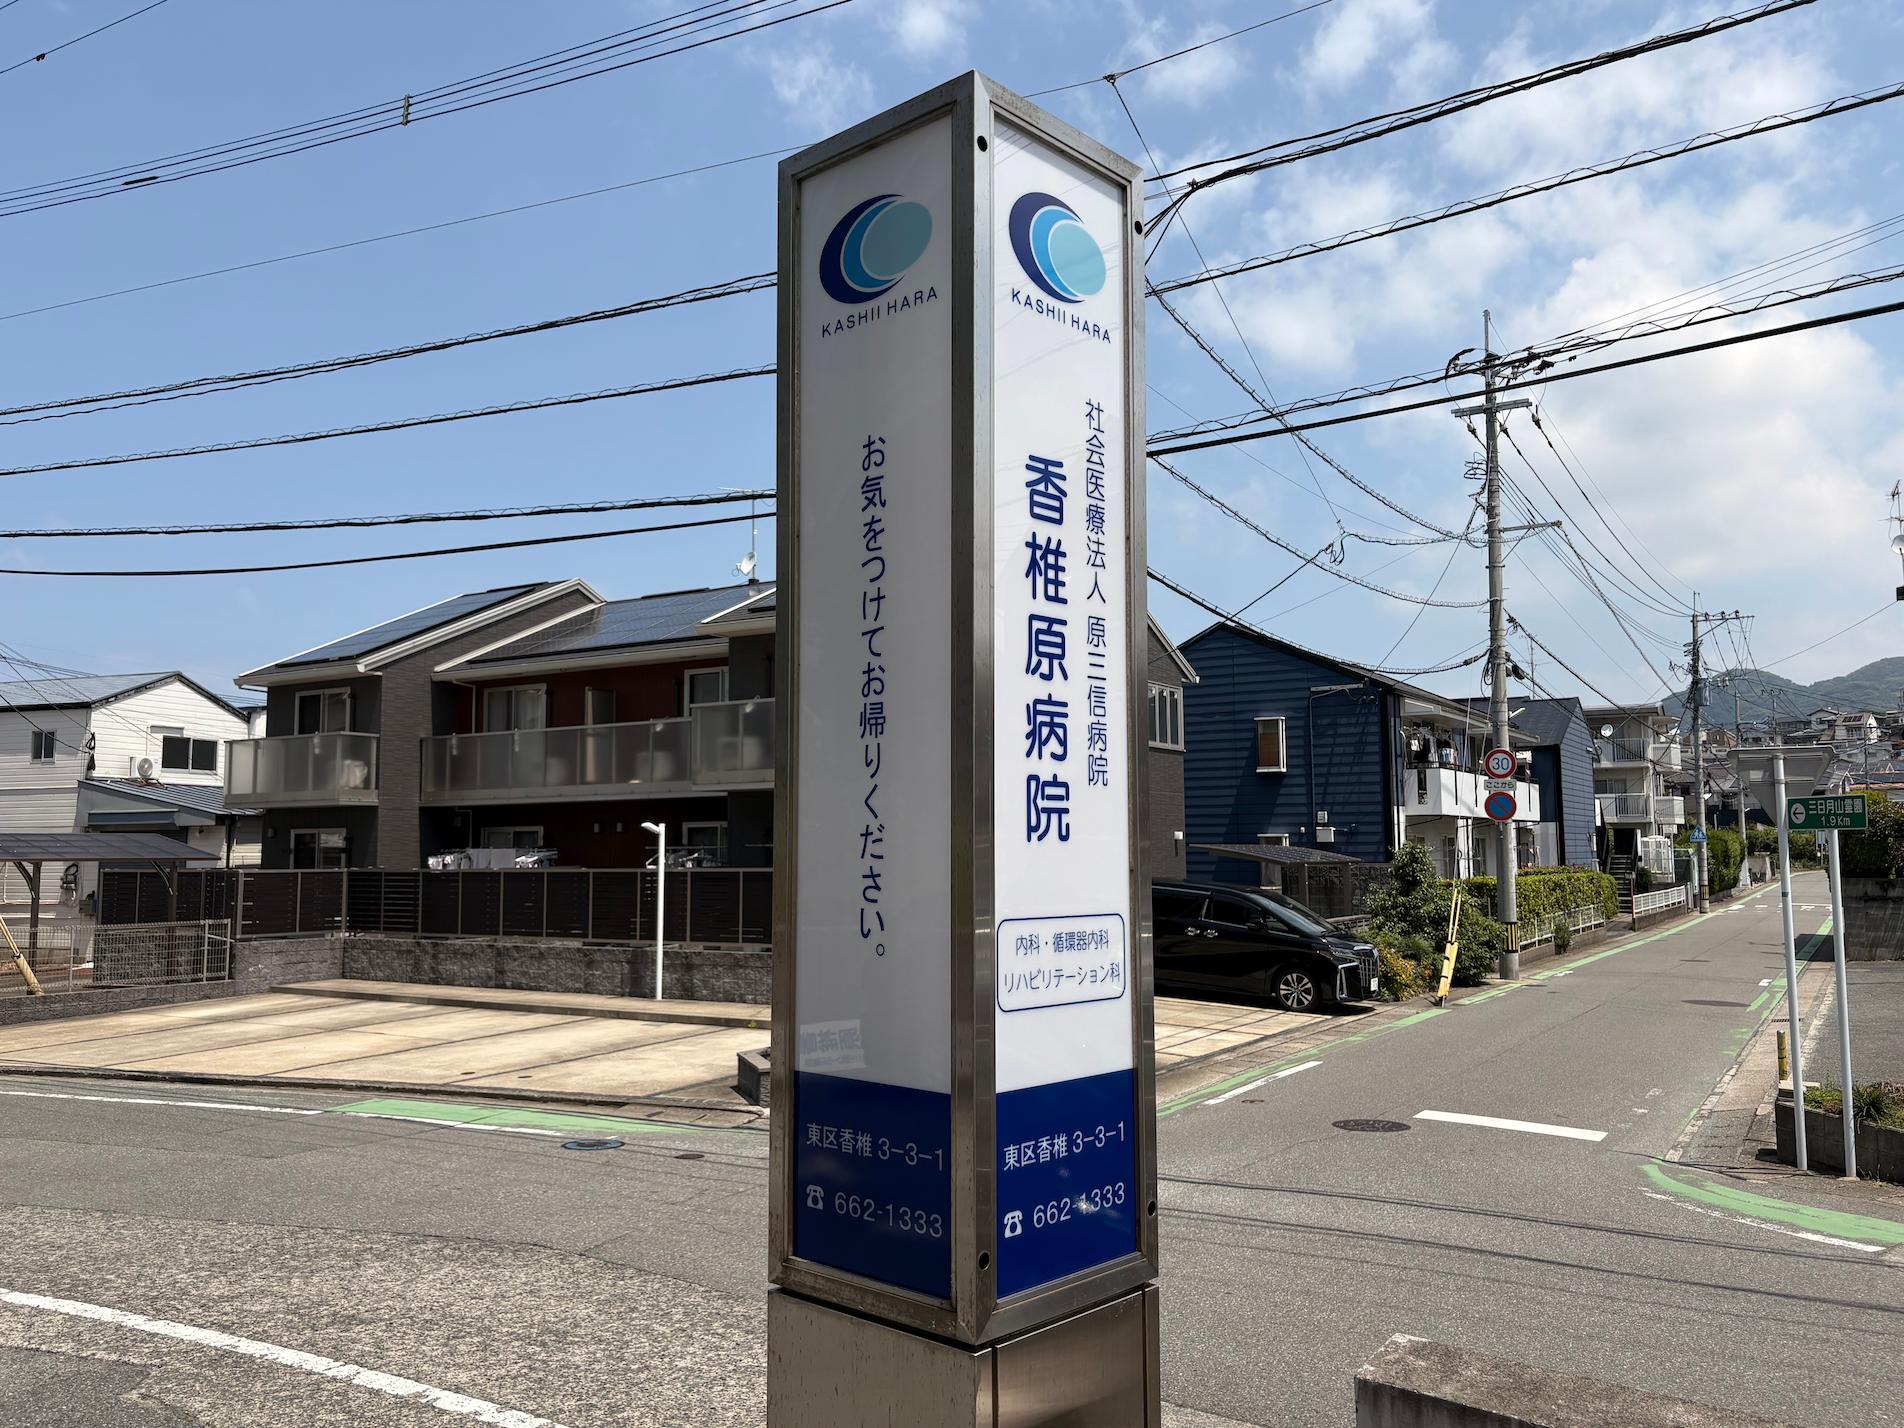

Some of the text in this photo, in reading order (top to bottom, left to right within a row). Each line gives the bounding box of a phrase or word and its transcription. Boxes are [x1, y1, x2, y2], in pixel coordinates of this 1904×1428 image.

[821, 285, 938, 339] KASHII HARA
[1011, 287, 1111, 344] KASHII HARA
[1085, 398, 1108, 787] 社会医療法人 原三信病院
[1024, 454, 1070, 843] 香椎原病院
[859, 434, 887, 957] お気をつけてお帰りください。
[1486, 781, 1515, 789] ここから
[1492, 757, 1510, 771] 30
[1808, 799, 1863, 814] 三日月山霊園
[1015, 929, 1109, 956] 内科・循環器内科
[1003, 962, 1121, 993] リハビリテーション科
[834, 1192, 943, 1238] 662-1333
[1033, 1182, 1126, 1228] 662-1333
